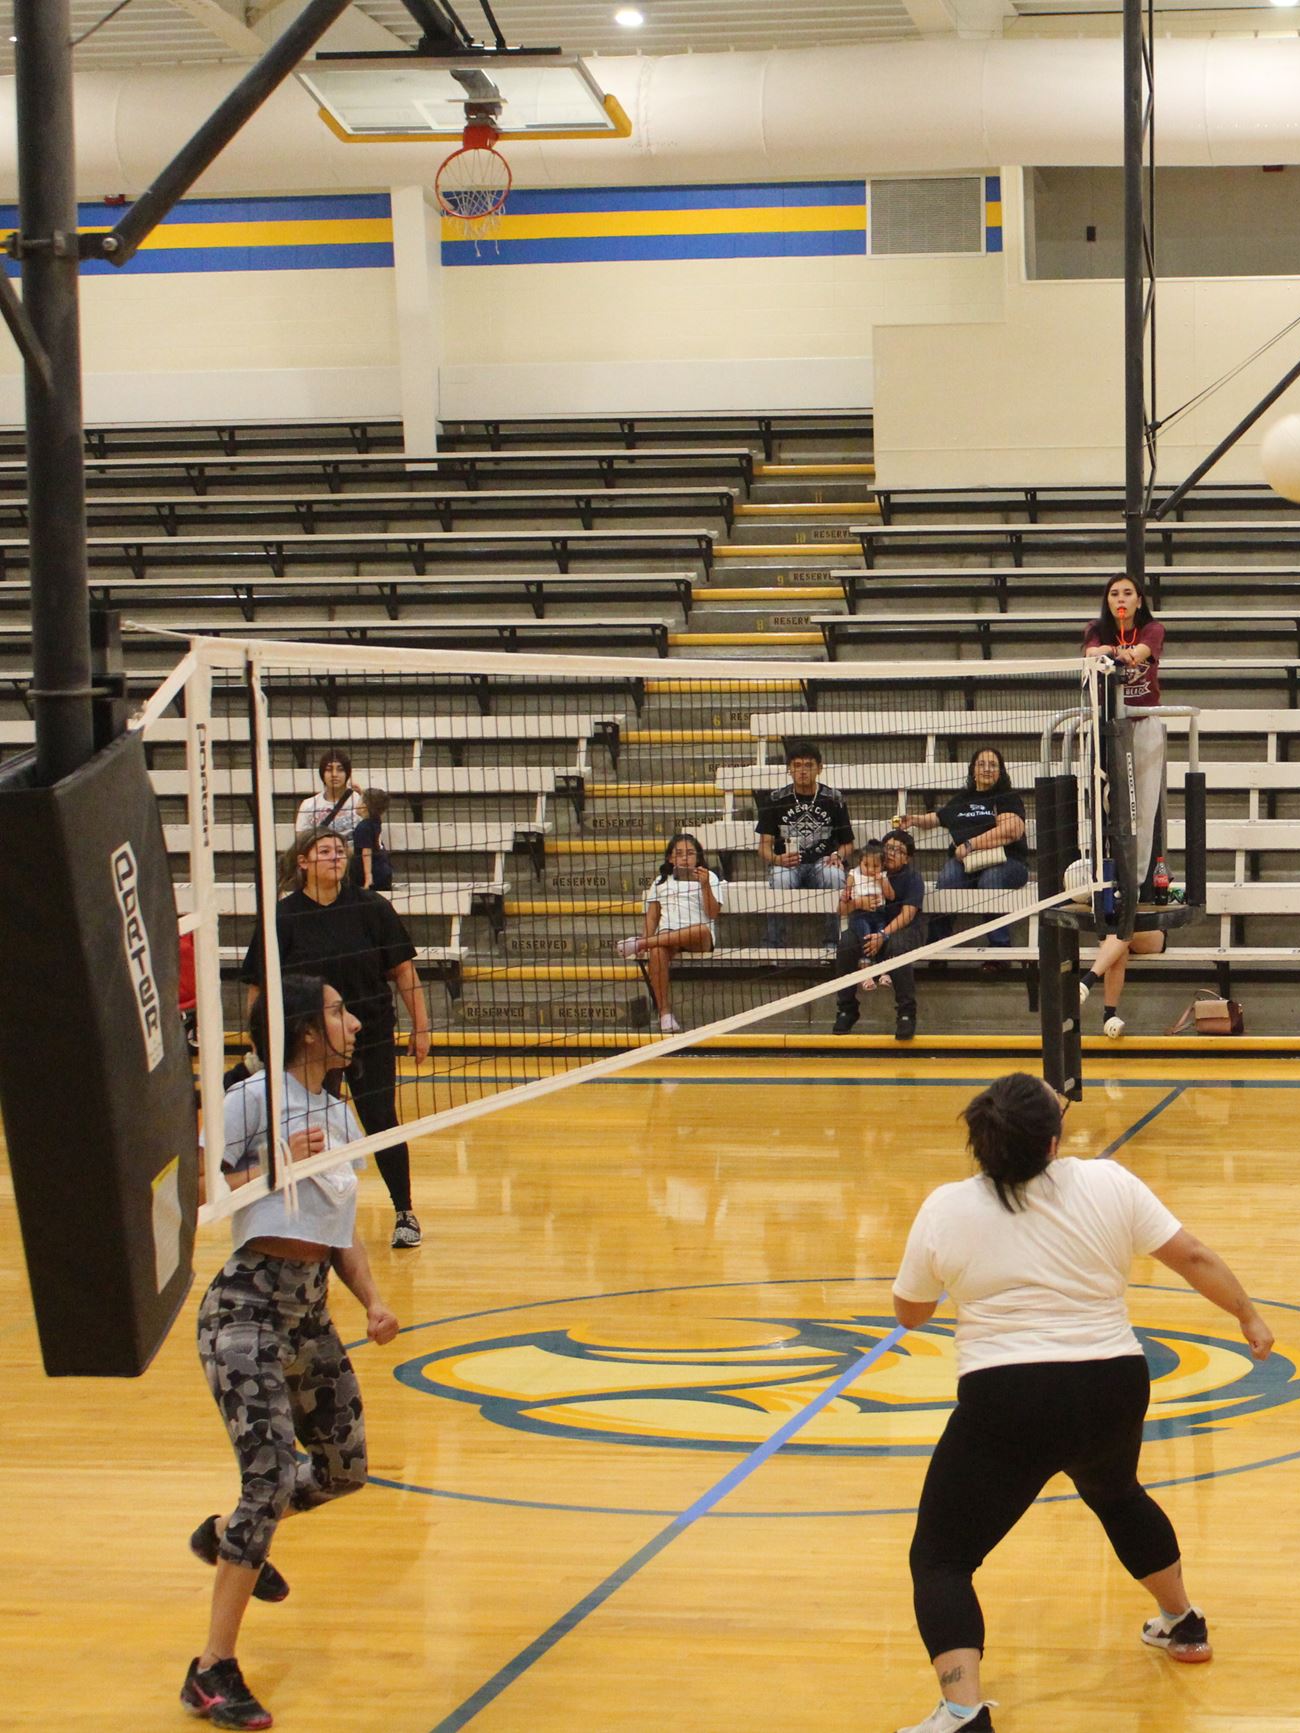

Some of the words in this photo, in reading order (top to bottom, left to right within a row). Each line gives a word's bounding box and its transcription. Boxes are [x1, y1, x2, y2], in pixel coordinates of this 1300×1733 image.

[795, 532, 806, 544] 10
[813, 530, 851, 539] RESERV
[777, 575, 784, 585] 9
[774, 617, 810, 626] RESERV
[592, 818, 643, 828] RESERVED
[552, 877, 606, 887] RESERVED
[511, 939, 567, 950] RESERVED
[467, 1007, 524, 1017] RESERVED
[558, 1007, 617, 1018] RESERVED
